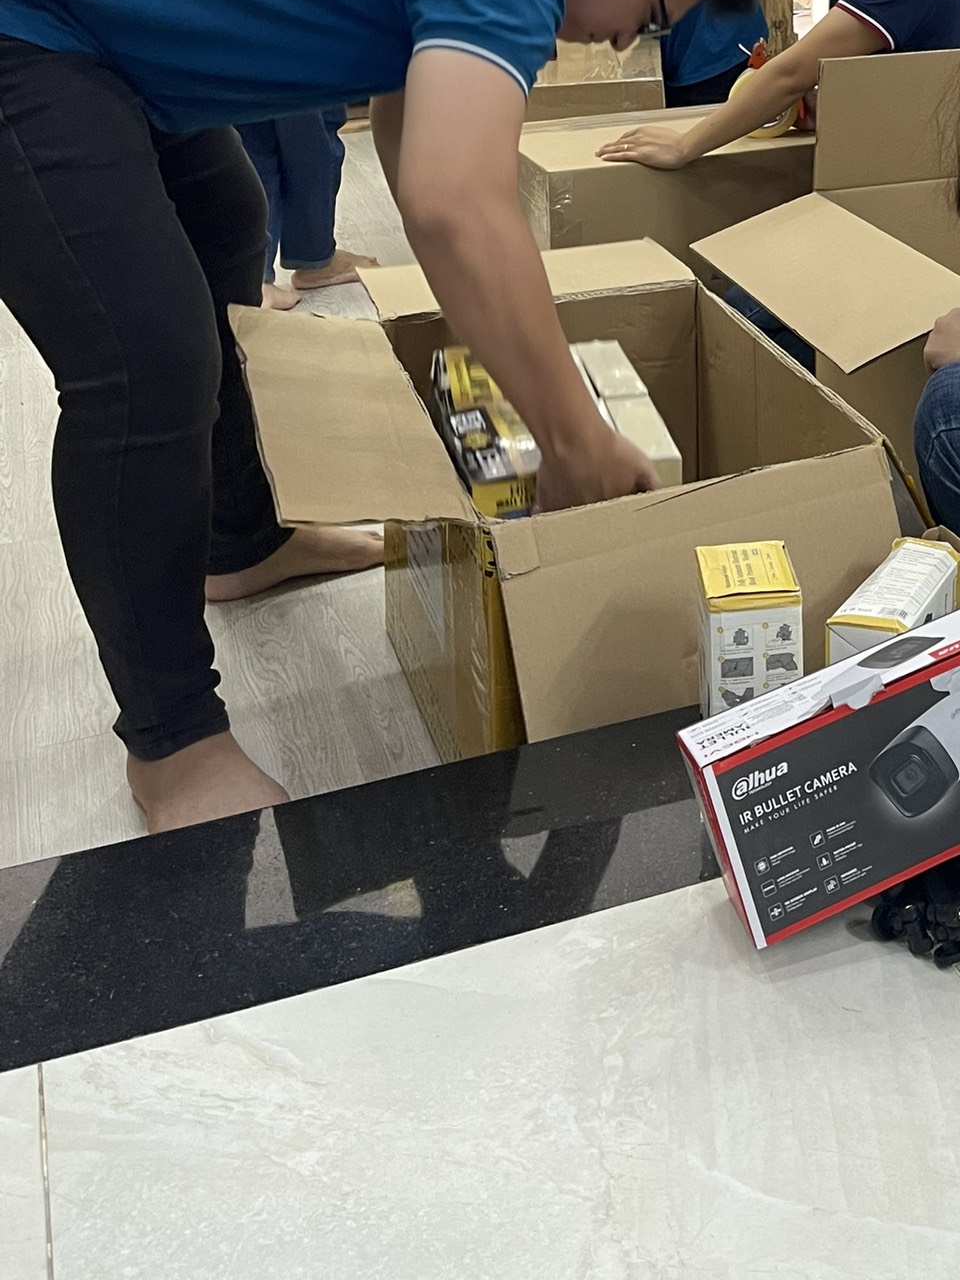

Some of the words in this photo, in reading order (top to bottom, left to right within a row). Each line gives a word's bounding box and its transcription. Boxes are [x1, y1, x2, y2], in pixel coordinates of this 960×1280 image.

[739, 810, 753, 826] IR
[754, 785, 802, 817] BULLET
[804, 761, 858, 793] CAMERA
[743, 820, 764, 834] MAKE
[768, 807, 790, 821] YOUR
[793, 797, 811, 810] LIFE
[813, 784, 838, 800] SAFER
